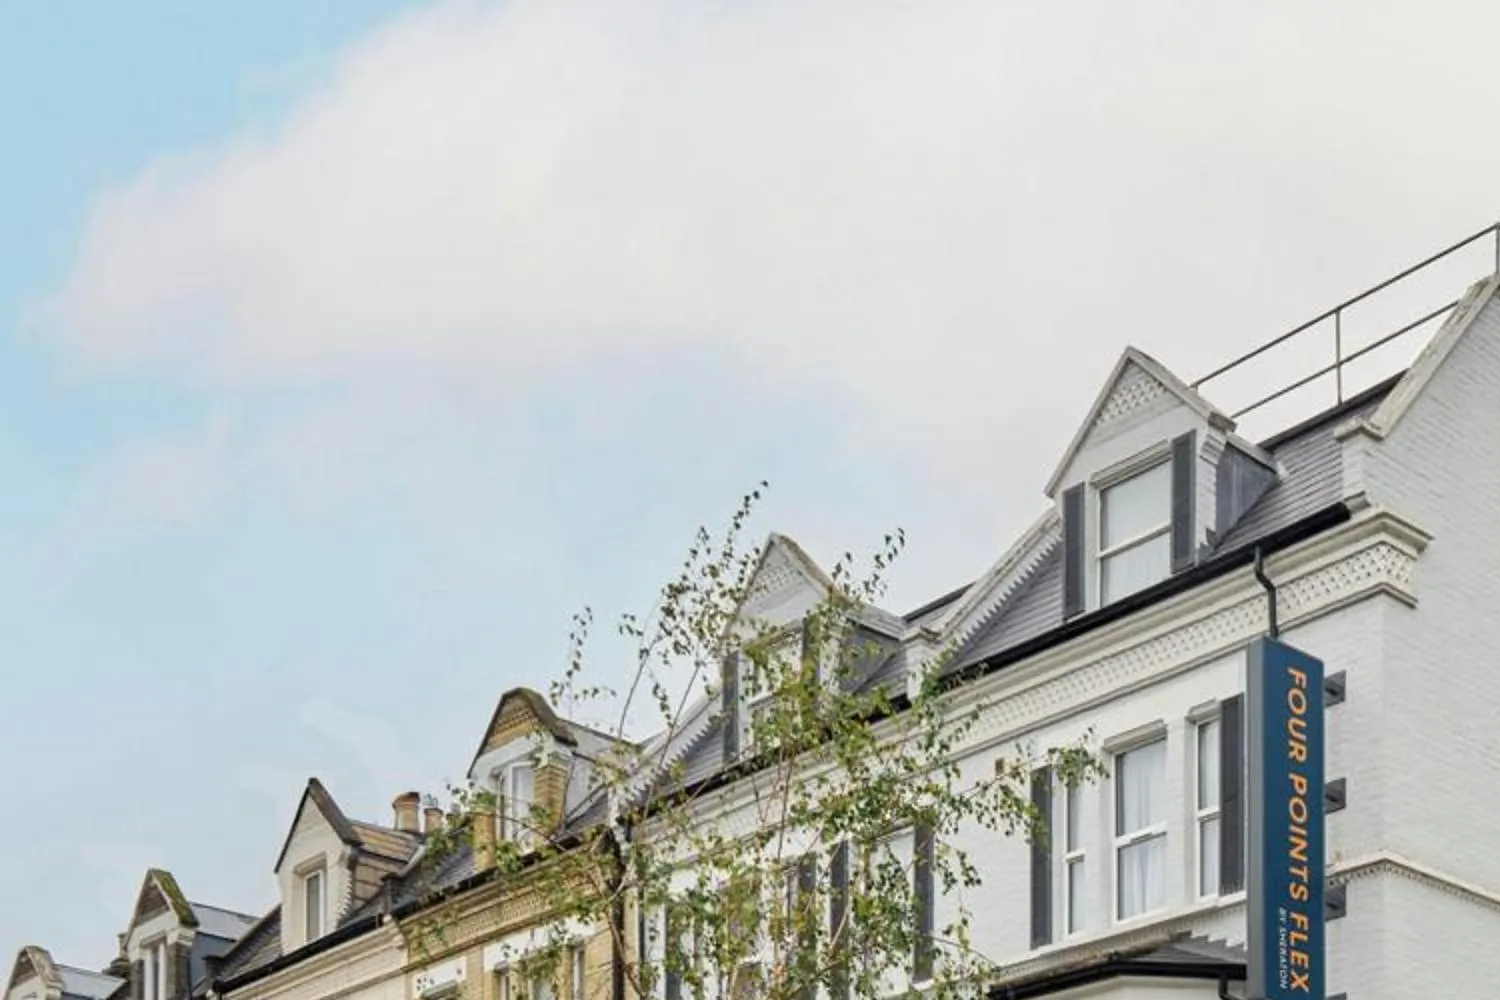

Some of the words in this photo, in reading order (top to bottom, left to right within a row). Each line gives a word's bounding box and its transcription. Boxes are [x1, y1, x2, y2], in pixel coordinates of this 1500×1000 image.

[1287, 667, 1308, 763] FOUR
[1288, 772, 1309, 902] POINTS
[1289, 911, 1310, 994] FLEX
